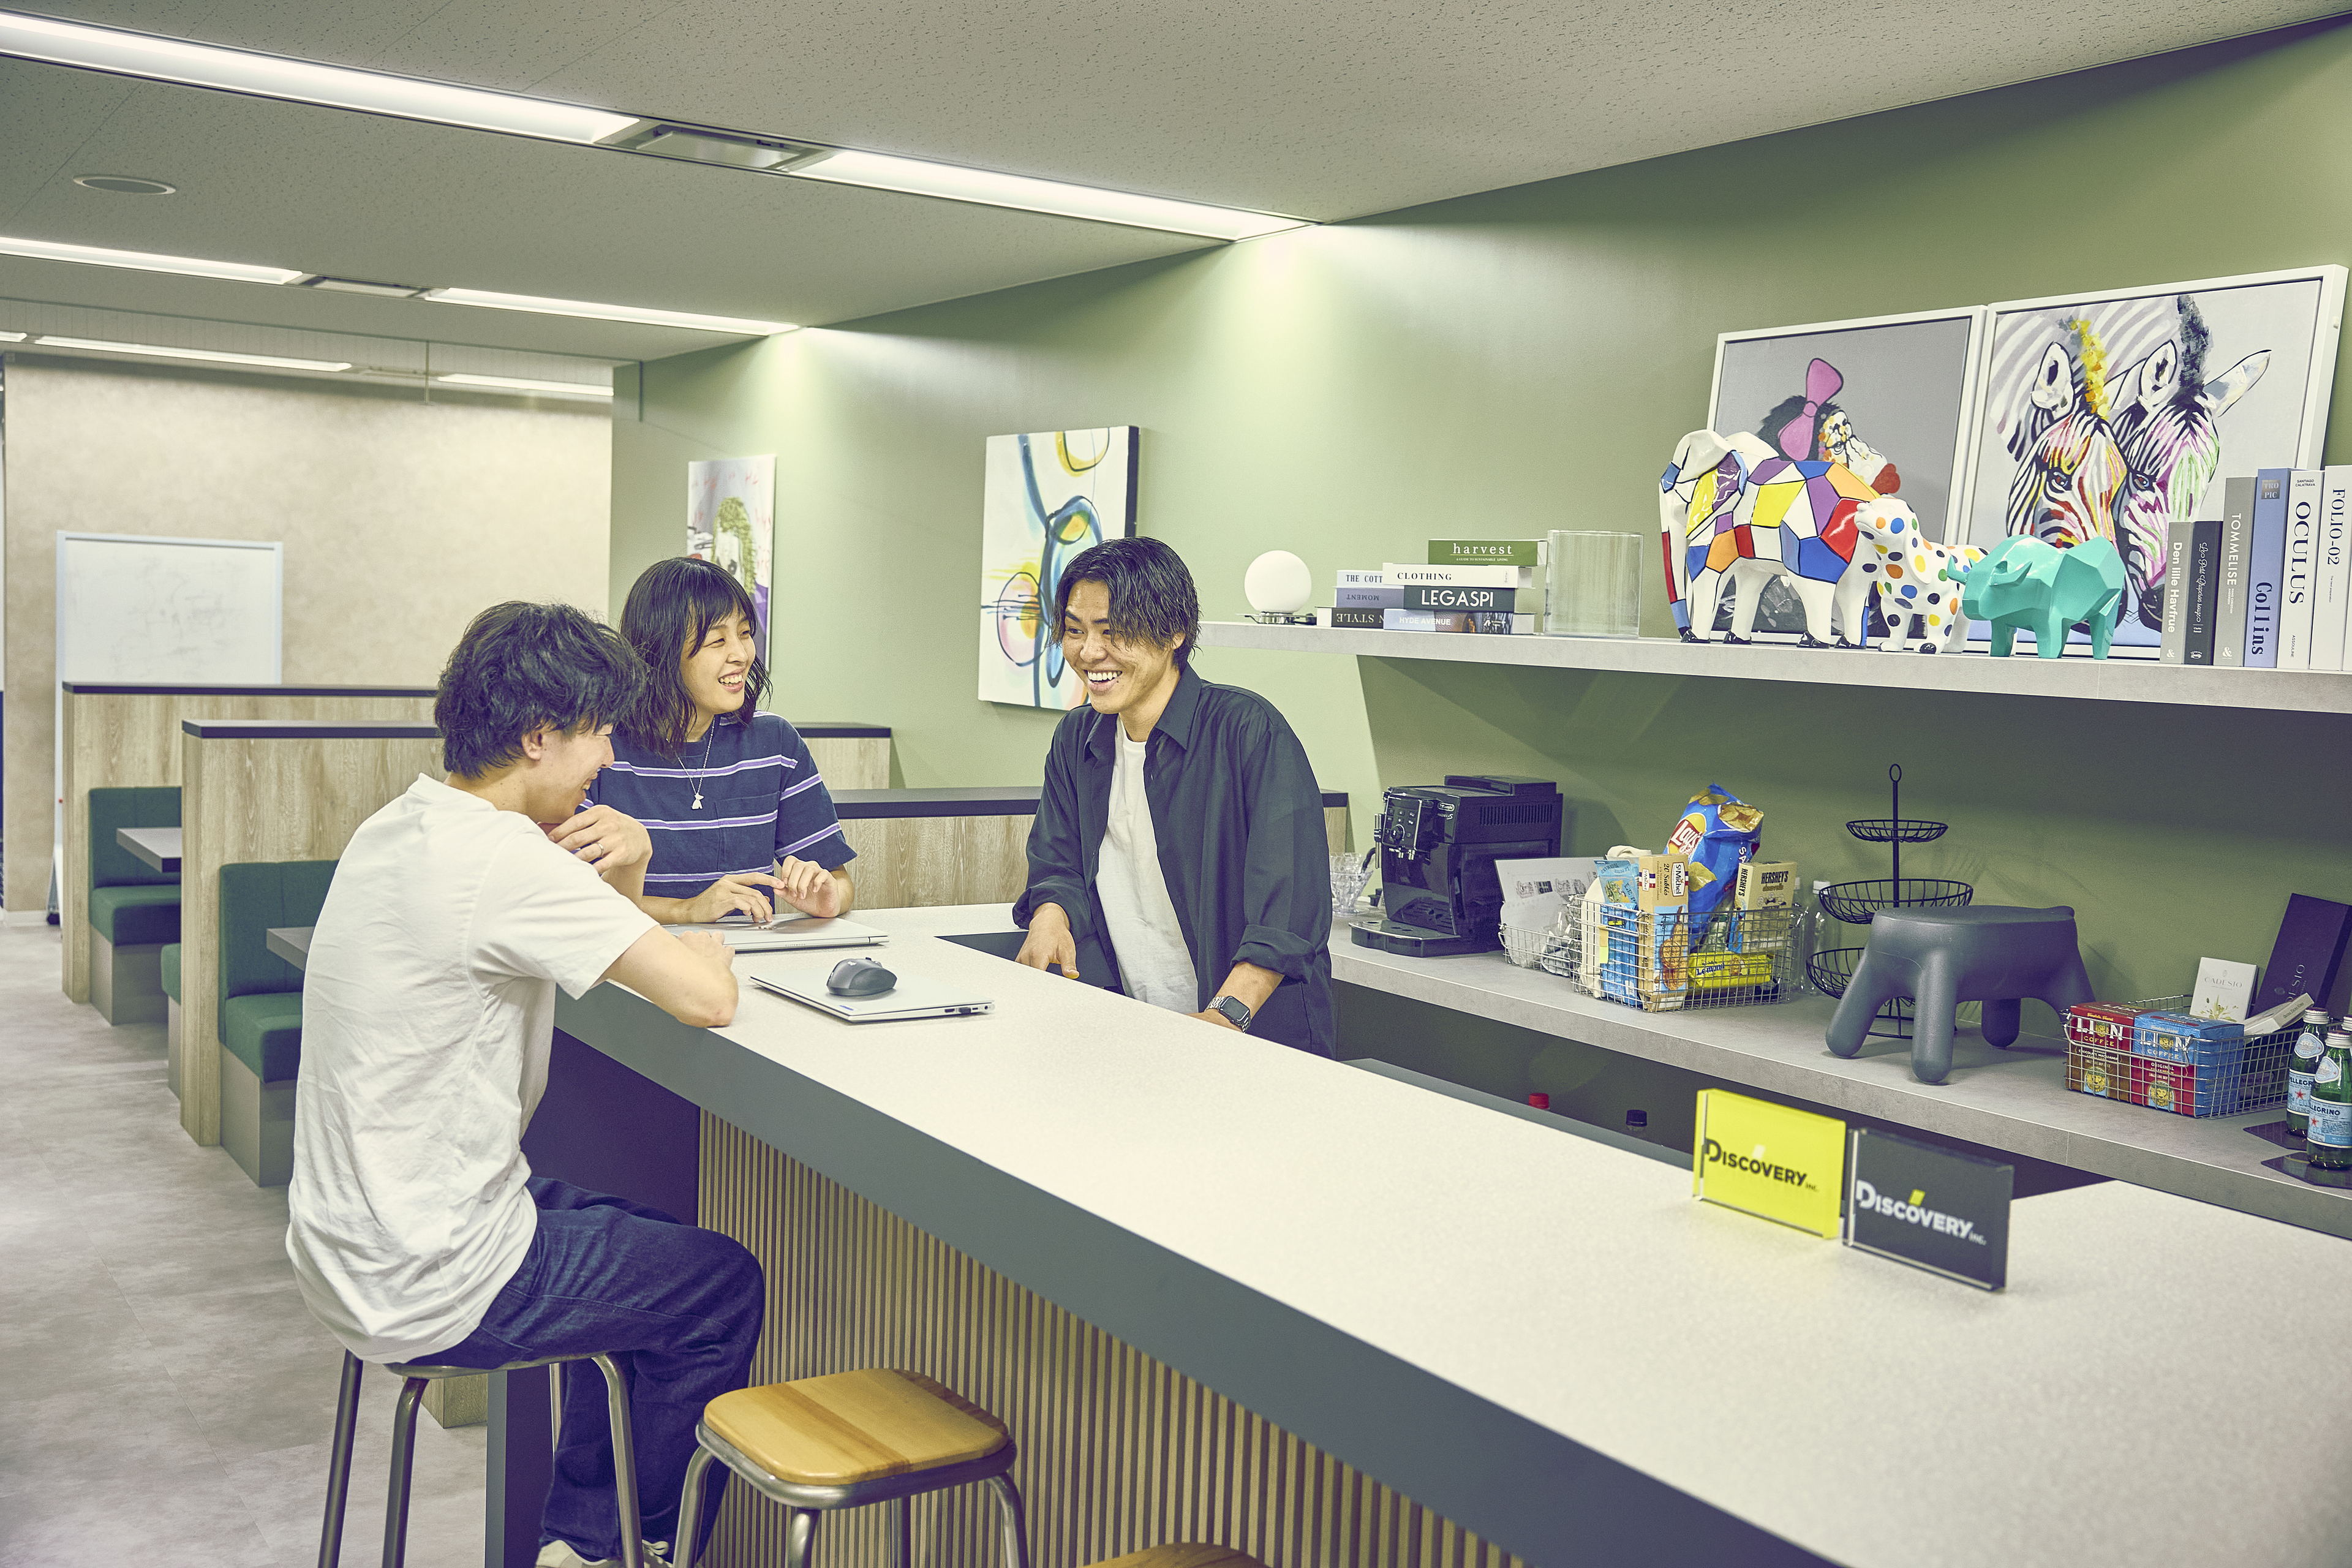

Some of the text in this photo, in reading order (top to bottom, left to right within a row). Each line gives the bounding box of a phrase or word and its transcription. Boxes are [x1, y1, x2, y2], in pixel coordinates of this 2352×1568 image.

[2328, 489, 2345, 565] FOLIO-02
[1453, 543, 1512, 554] harvest
[2199, 542, 2209, 559] Le
[2227, 513, 2242, 586] TOMMELISE
[2289, 502, 2311, 603] OCULUS
[1397, 572, 1452, 581] CLOTHING
[2168, 542, 2183, 633] Den lille Havfrue
[1422, 589, 1494, 607] LEGASPI
[1336, 613, 1374, 623] STYLE
[2252, 582, 2272, 655] Collins
[1664, 863, 1670, 872] 20
[2084, 1036, 2114, 1047] COFFEE
[1705, 1138, 1807, 1186] DISCOVERY
[1856, 1179, 1974, 1240] DISCOVERY
